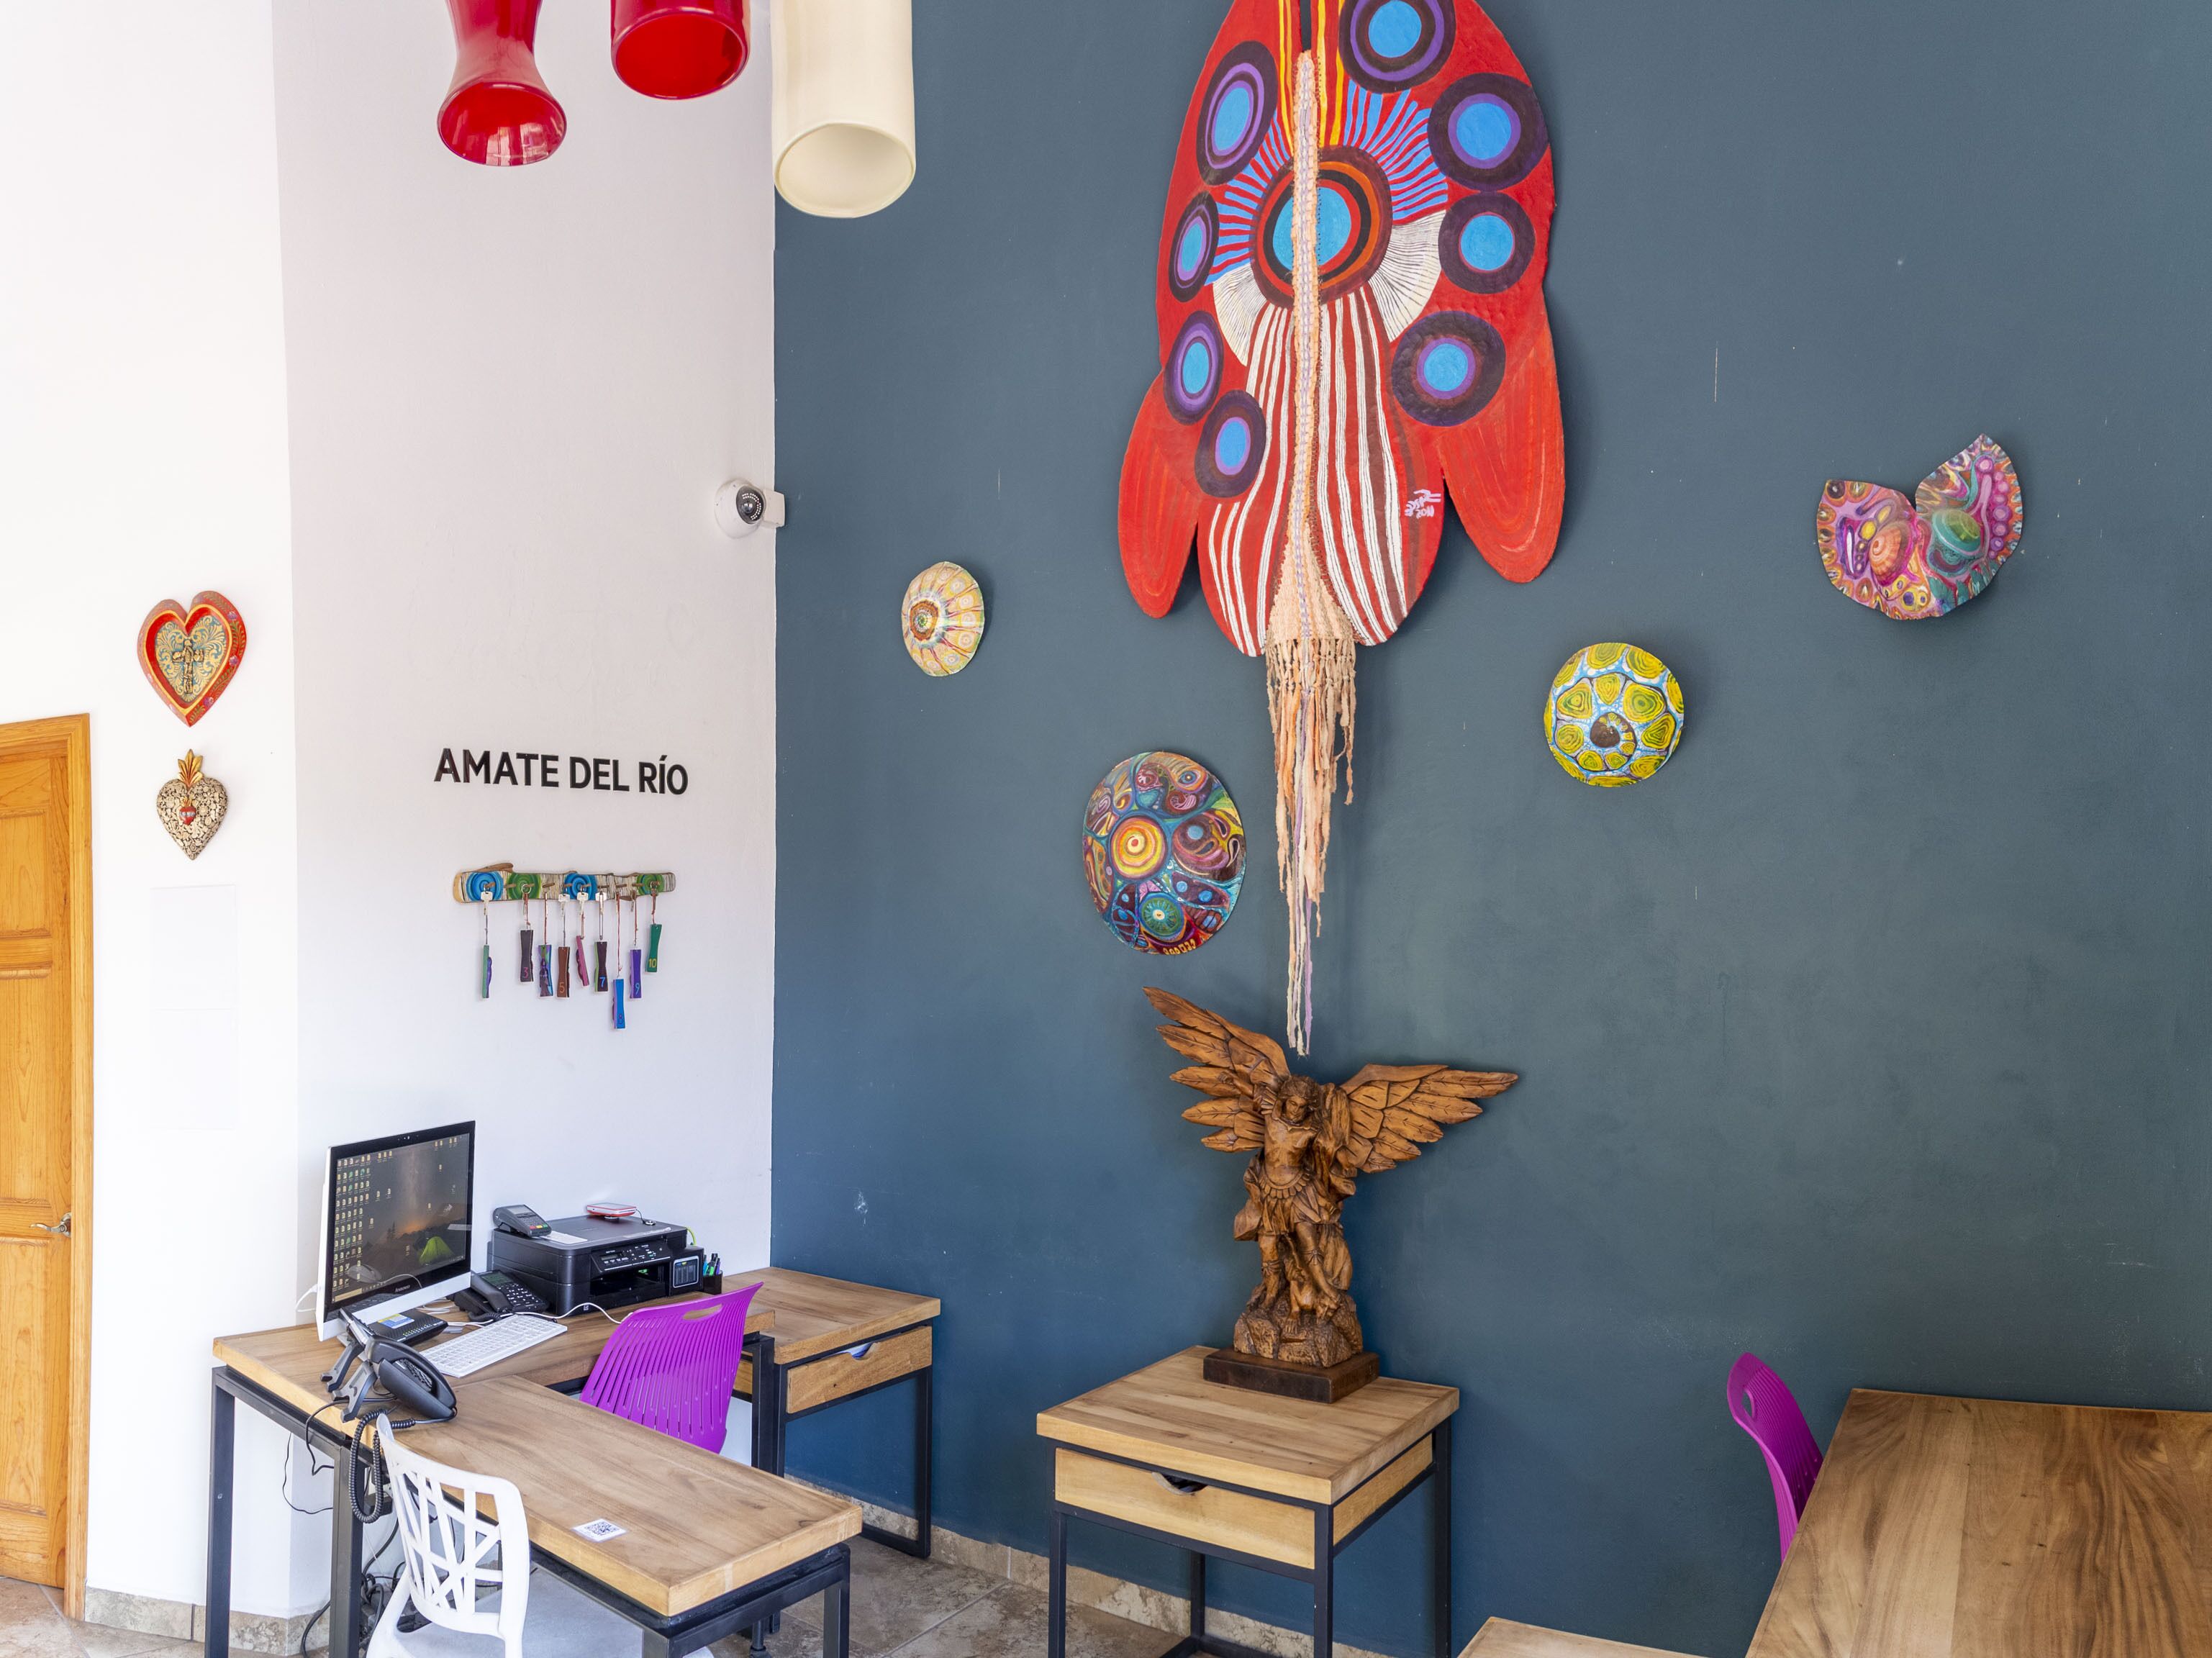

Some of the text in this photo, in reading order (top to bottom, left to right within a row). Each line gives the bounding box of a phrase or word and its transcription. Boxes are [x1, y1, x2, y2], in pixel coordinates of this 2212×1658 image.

[434, 748, 689, 795] AMATE DEL RÍO
[648, 958, 657, 969] 10
[523, 966, 529, 979] 3
[559, 982, 565, 994] 5
[599, 977, 605, 988] 7
[635, 982, 640, 995] 9
